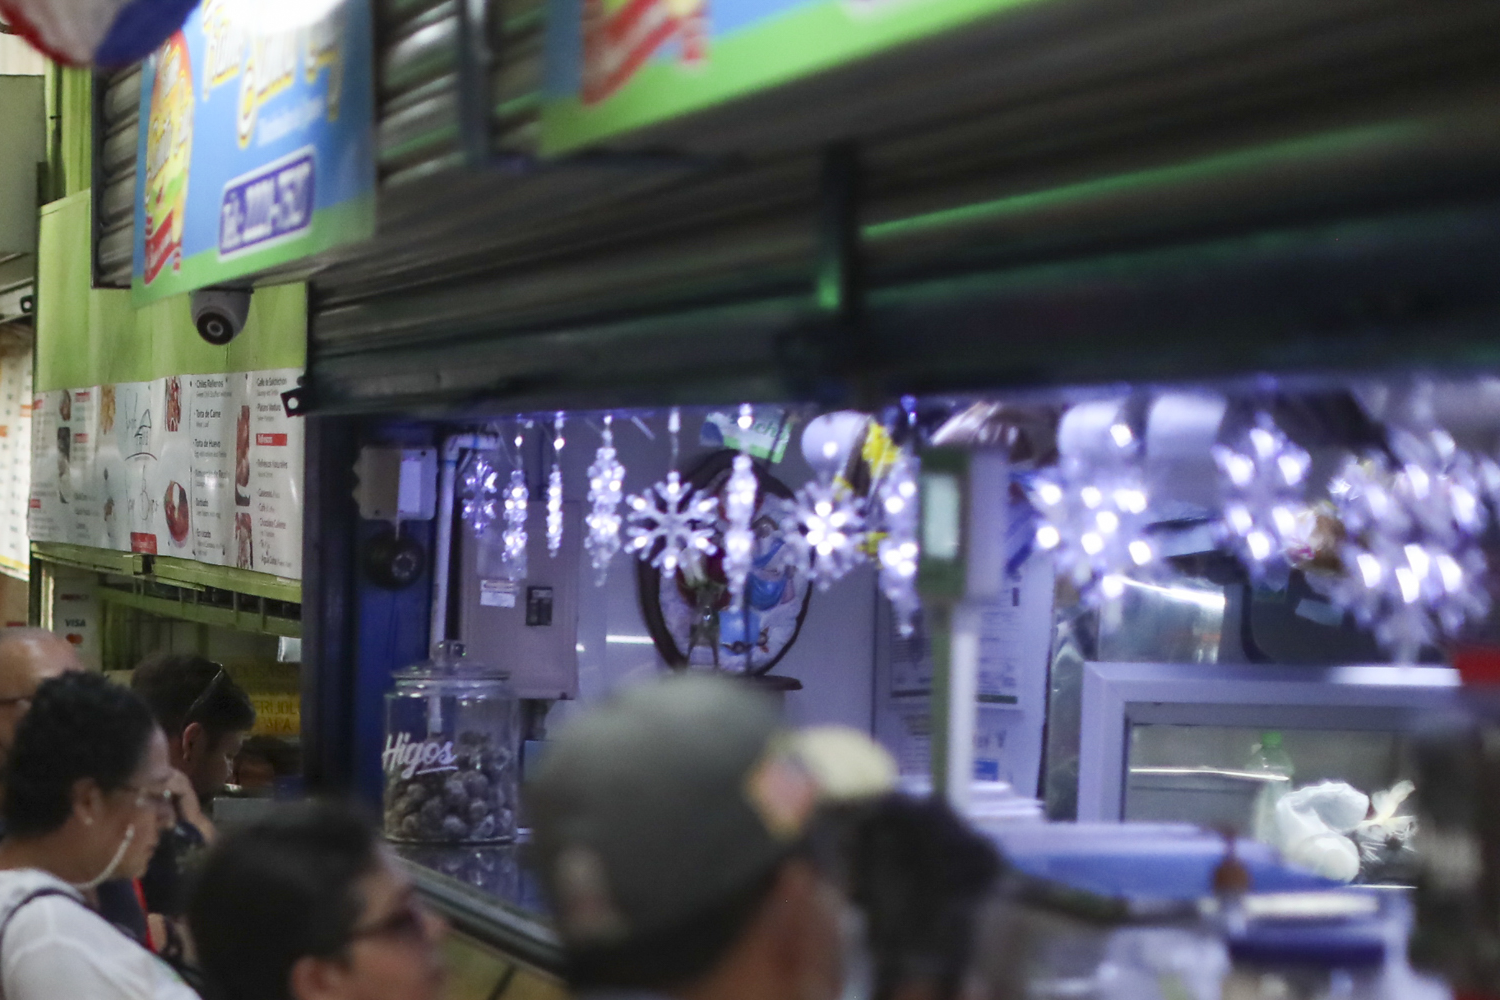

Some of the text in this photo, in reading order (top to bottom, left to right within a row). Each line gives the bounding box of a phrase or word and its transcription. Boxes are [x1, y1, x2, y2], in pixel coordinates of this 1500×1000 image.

[65, 619, 86, 627] VISA
[252, 700, 300, 715] FRIJOL
[382, 731, 458, 780] Higos
